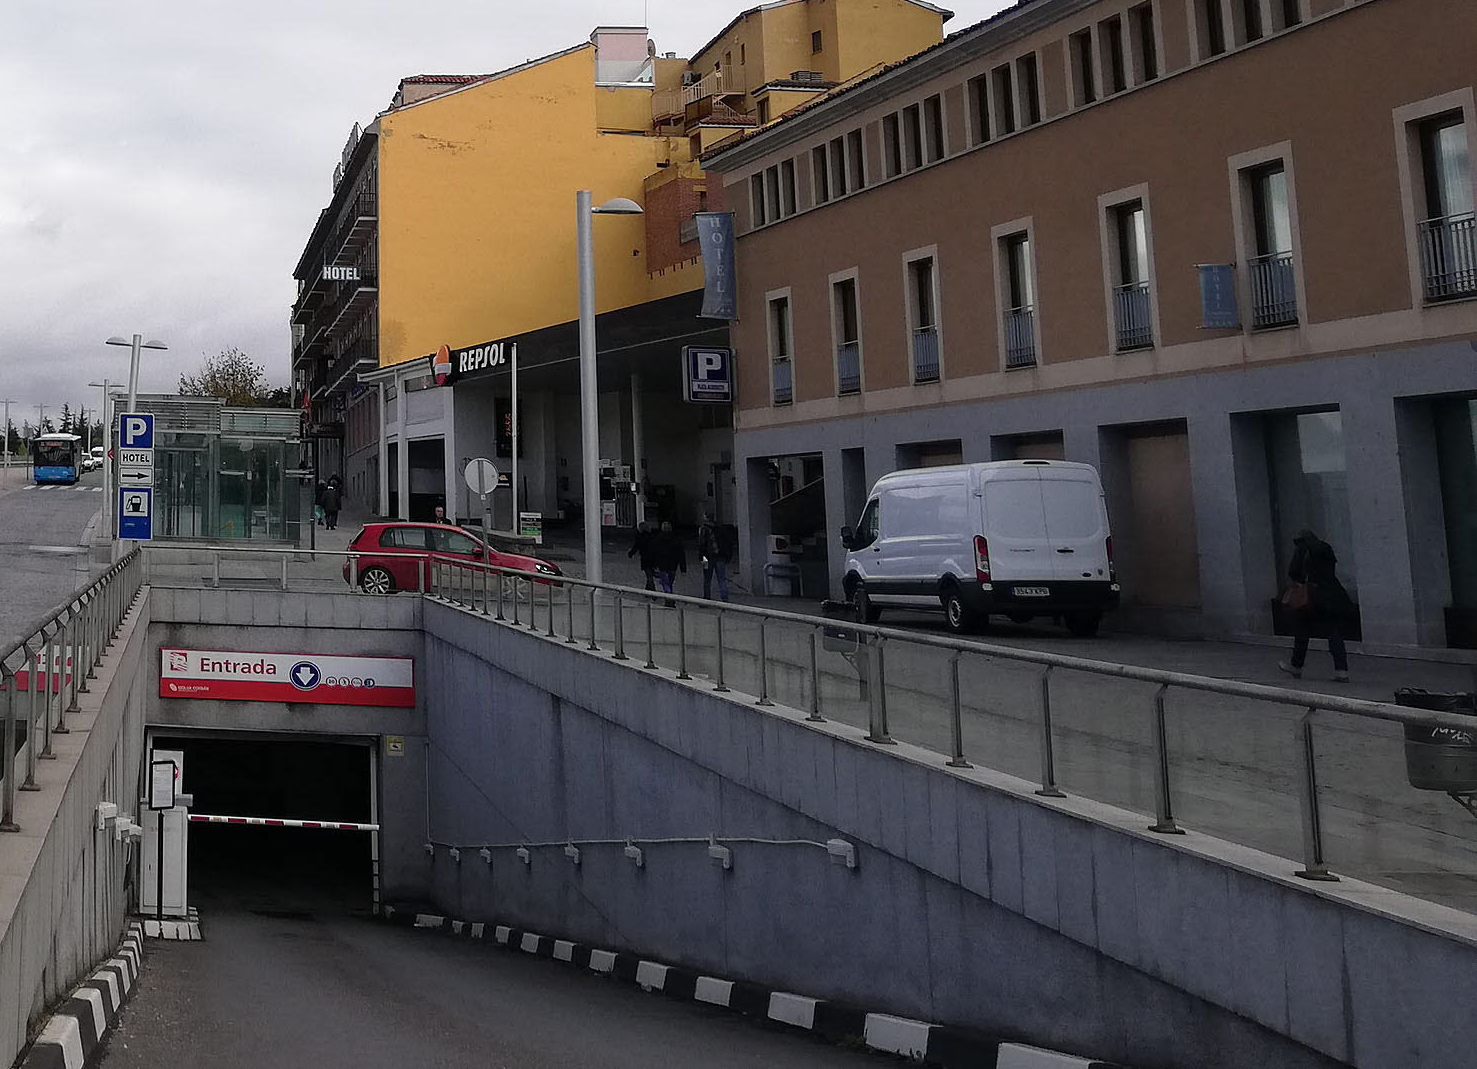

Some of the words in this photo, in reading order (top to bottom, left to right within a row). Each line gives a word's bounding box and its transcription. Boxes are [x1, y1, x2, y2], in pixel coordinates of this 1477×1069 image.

[708, 217, 725, 293] HOTEL
[323, 266, 361, 280] HOTEL
[459, 342, 506, 373] REPSOL
[697, 352, 722, 379] P
[126, 417, 147, 445] P
[122, 453, 150, 463] HOTEL
[199, 657, 277, 675] Entrada
